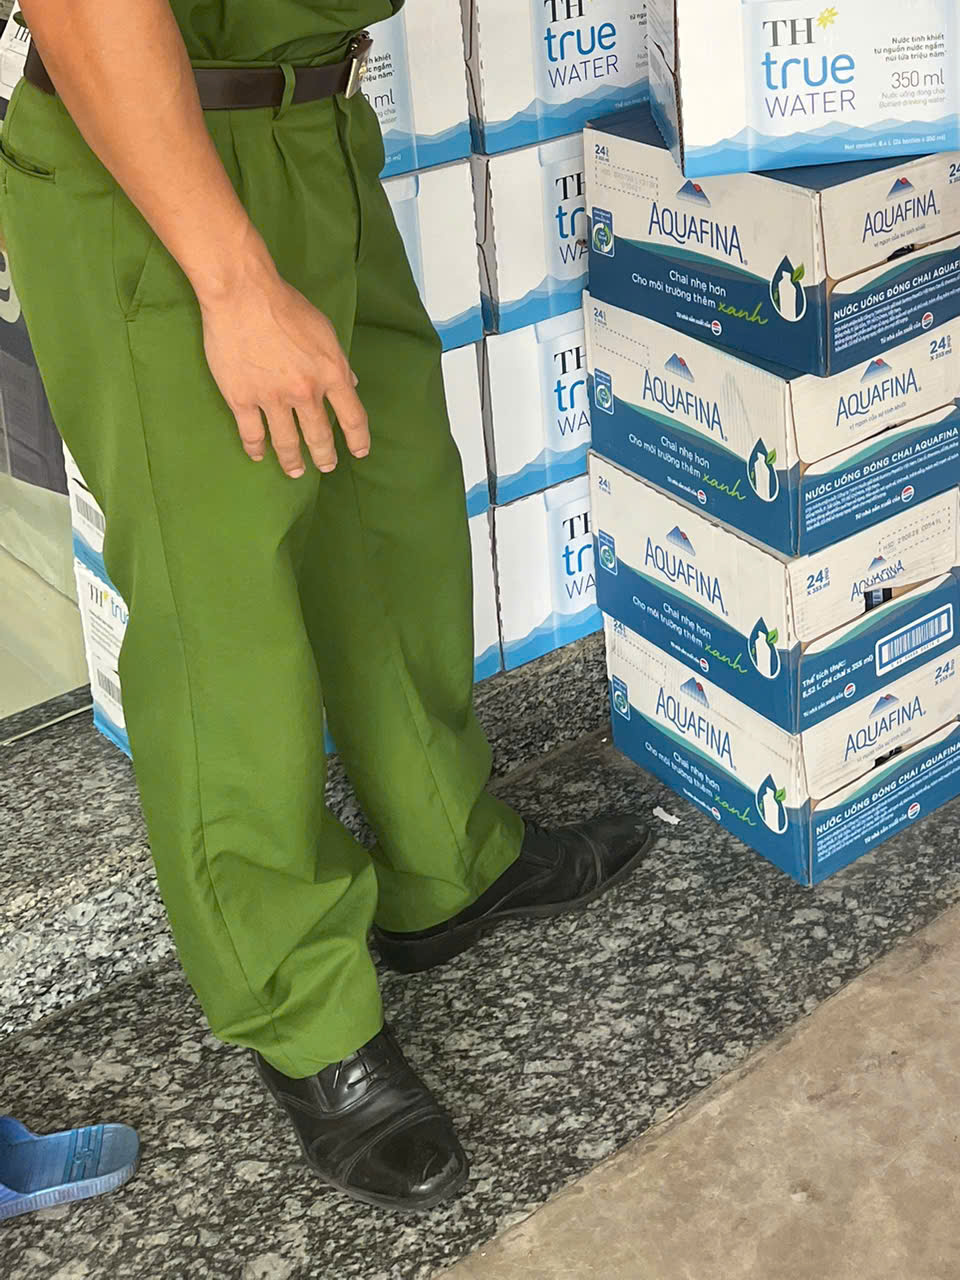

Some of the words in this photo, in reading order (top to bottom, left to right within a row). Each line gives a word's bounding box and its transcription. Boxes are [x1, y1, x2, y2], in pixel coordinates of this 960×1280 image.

[544, 22, 617, 63] true
[763, 17, 816, 48] TH
[548, 53, 619, 89] WATER
[761, 51, 856, 90] true
[891, 70, 920, 90] 350
[924, 68, 945, 86] ml
[374, 88, 395, 108] ml
[764, 89, 857, 119] WATER
[595, 144, 607, 155] 24
[649, 202, 744, 263] AQUAFINA
[862, 190, 937, 243] AQUAFINA
[631, 273, 648, 286] Cho
[649, 278, 664, 291] môi
[665, 282, 692, 303] trường
[693, 292, 716, 308] thêm
[717, 302, 768, 325] xanh
[669, 270, 689, 285] Chai
[690, 275, 708, 291] nhẹ
[709, 281, 726, 297] hơn
[833, 301, 859, 320] NƯỚC
[860, 289, 885, 311] UỐNG
[886, 280, 911, 300] ĐÓNG
[912, 273, 932, 290] CHAI
[930, 338, 946, 355] 24
[643, 370, 725, 441] AQUAFINA
[836, 368, 917, 427] AQUAFINA
[628, 433, 643, 447] Cho
[643, 440, 657, 454] môi
[657, 446, 681, 469] trường
[681, 461, 701, 478] thêm
[703, 473, 747, 501] xanh
[660, 436, 678, 452] Chai
[679, 443, 693, 460] nhẹ
[694, 452, 710, 469] hơn
[805, 480, 832, 502] NƯỚC
[834, 469, 860, 490] UỐNG
[863, 457, 889, 478] ĐÓNG
[892, 447, 913, 463] CHAI
[915, 427, 958, 454] AQUAFINA
[644, 537, 726, 615] AQUAFINA
[806, 569, 824, 589] 24
[935, 661, 950, 678] 24
[656, 687, 737, 769] AQUAFINA
[844, 696, 923, 761] AQUAFINA
[816, 814, 842, 835] NƯỚC
[844, 800, 870, 820] UỐNG
[872, 785, 897, 804] ĐÓNG
[899, 770, 919, 786] CHAI
